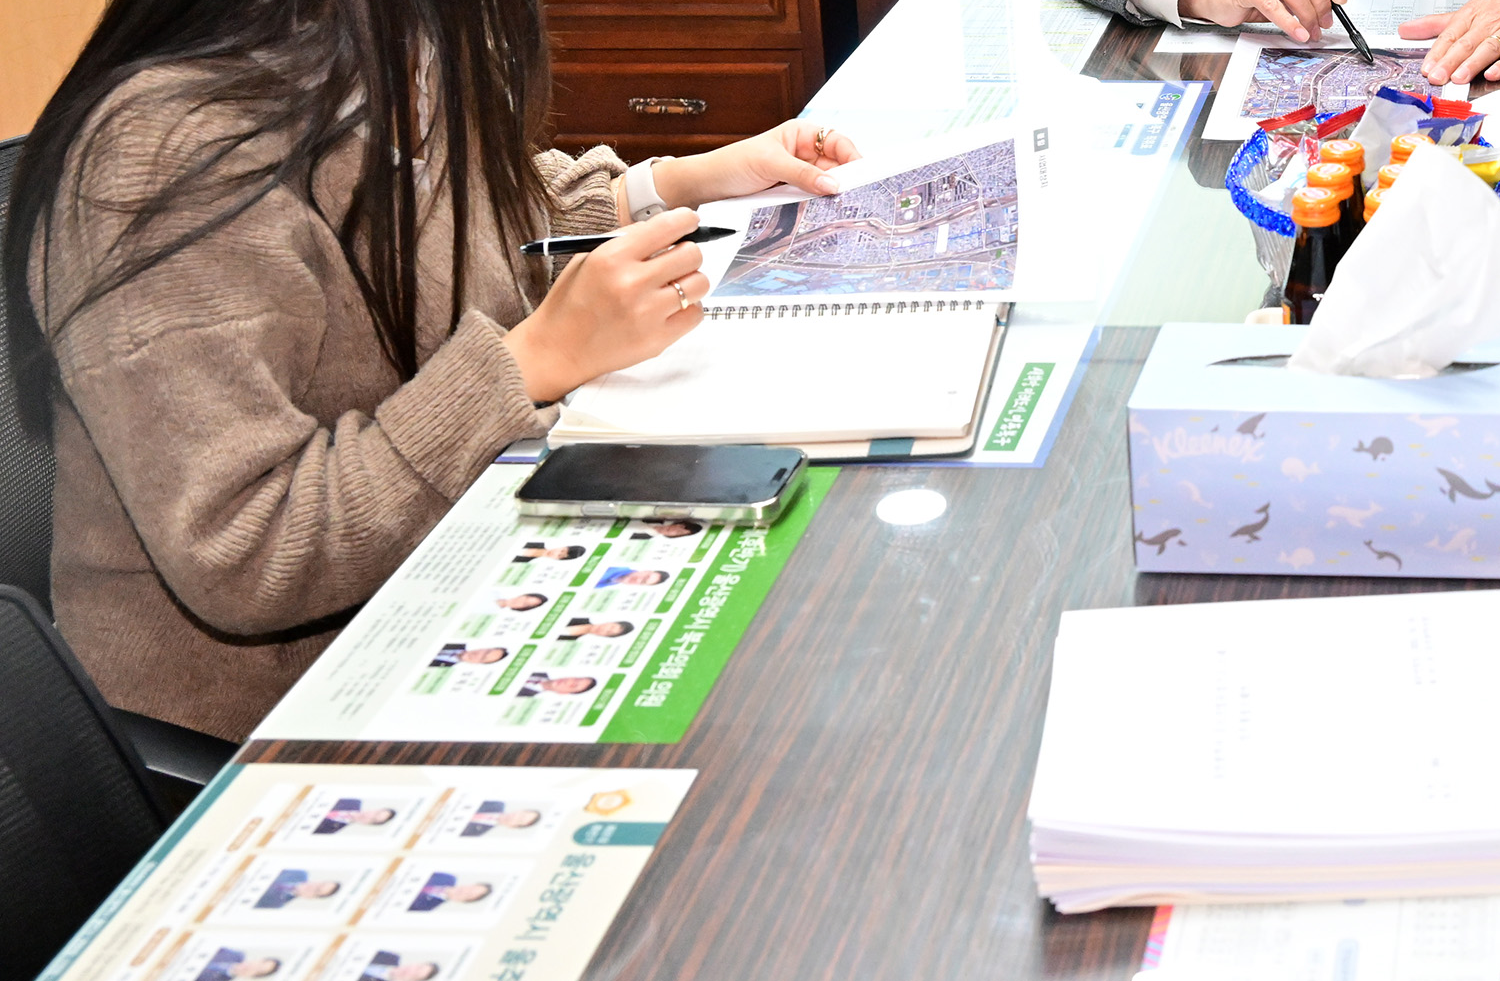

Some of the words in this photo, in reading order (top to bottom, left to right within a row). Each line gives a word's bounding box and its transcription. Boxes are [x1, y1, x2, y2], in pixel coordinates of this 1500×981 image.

[1152, 426, 1265, 464] Kleenex
[691, 572, 742, 631] 울산광역시
[658, 630, 705, 681] 북구의회
[634, 679, 674, 708] 의원
[513, 853, 596, 941] 울산광역시
